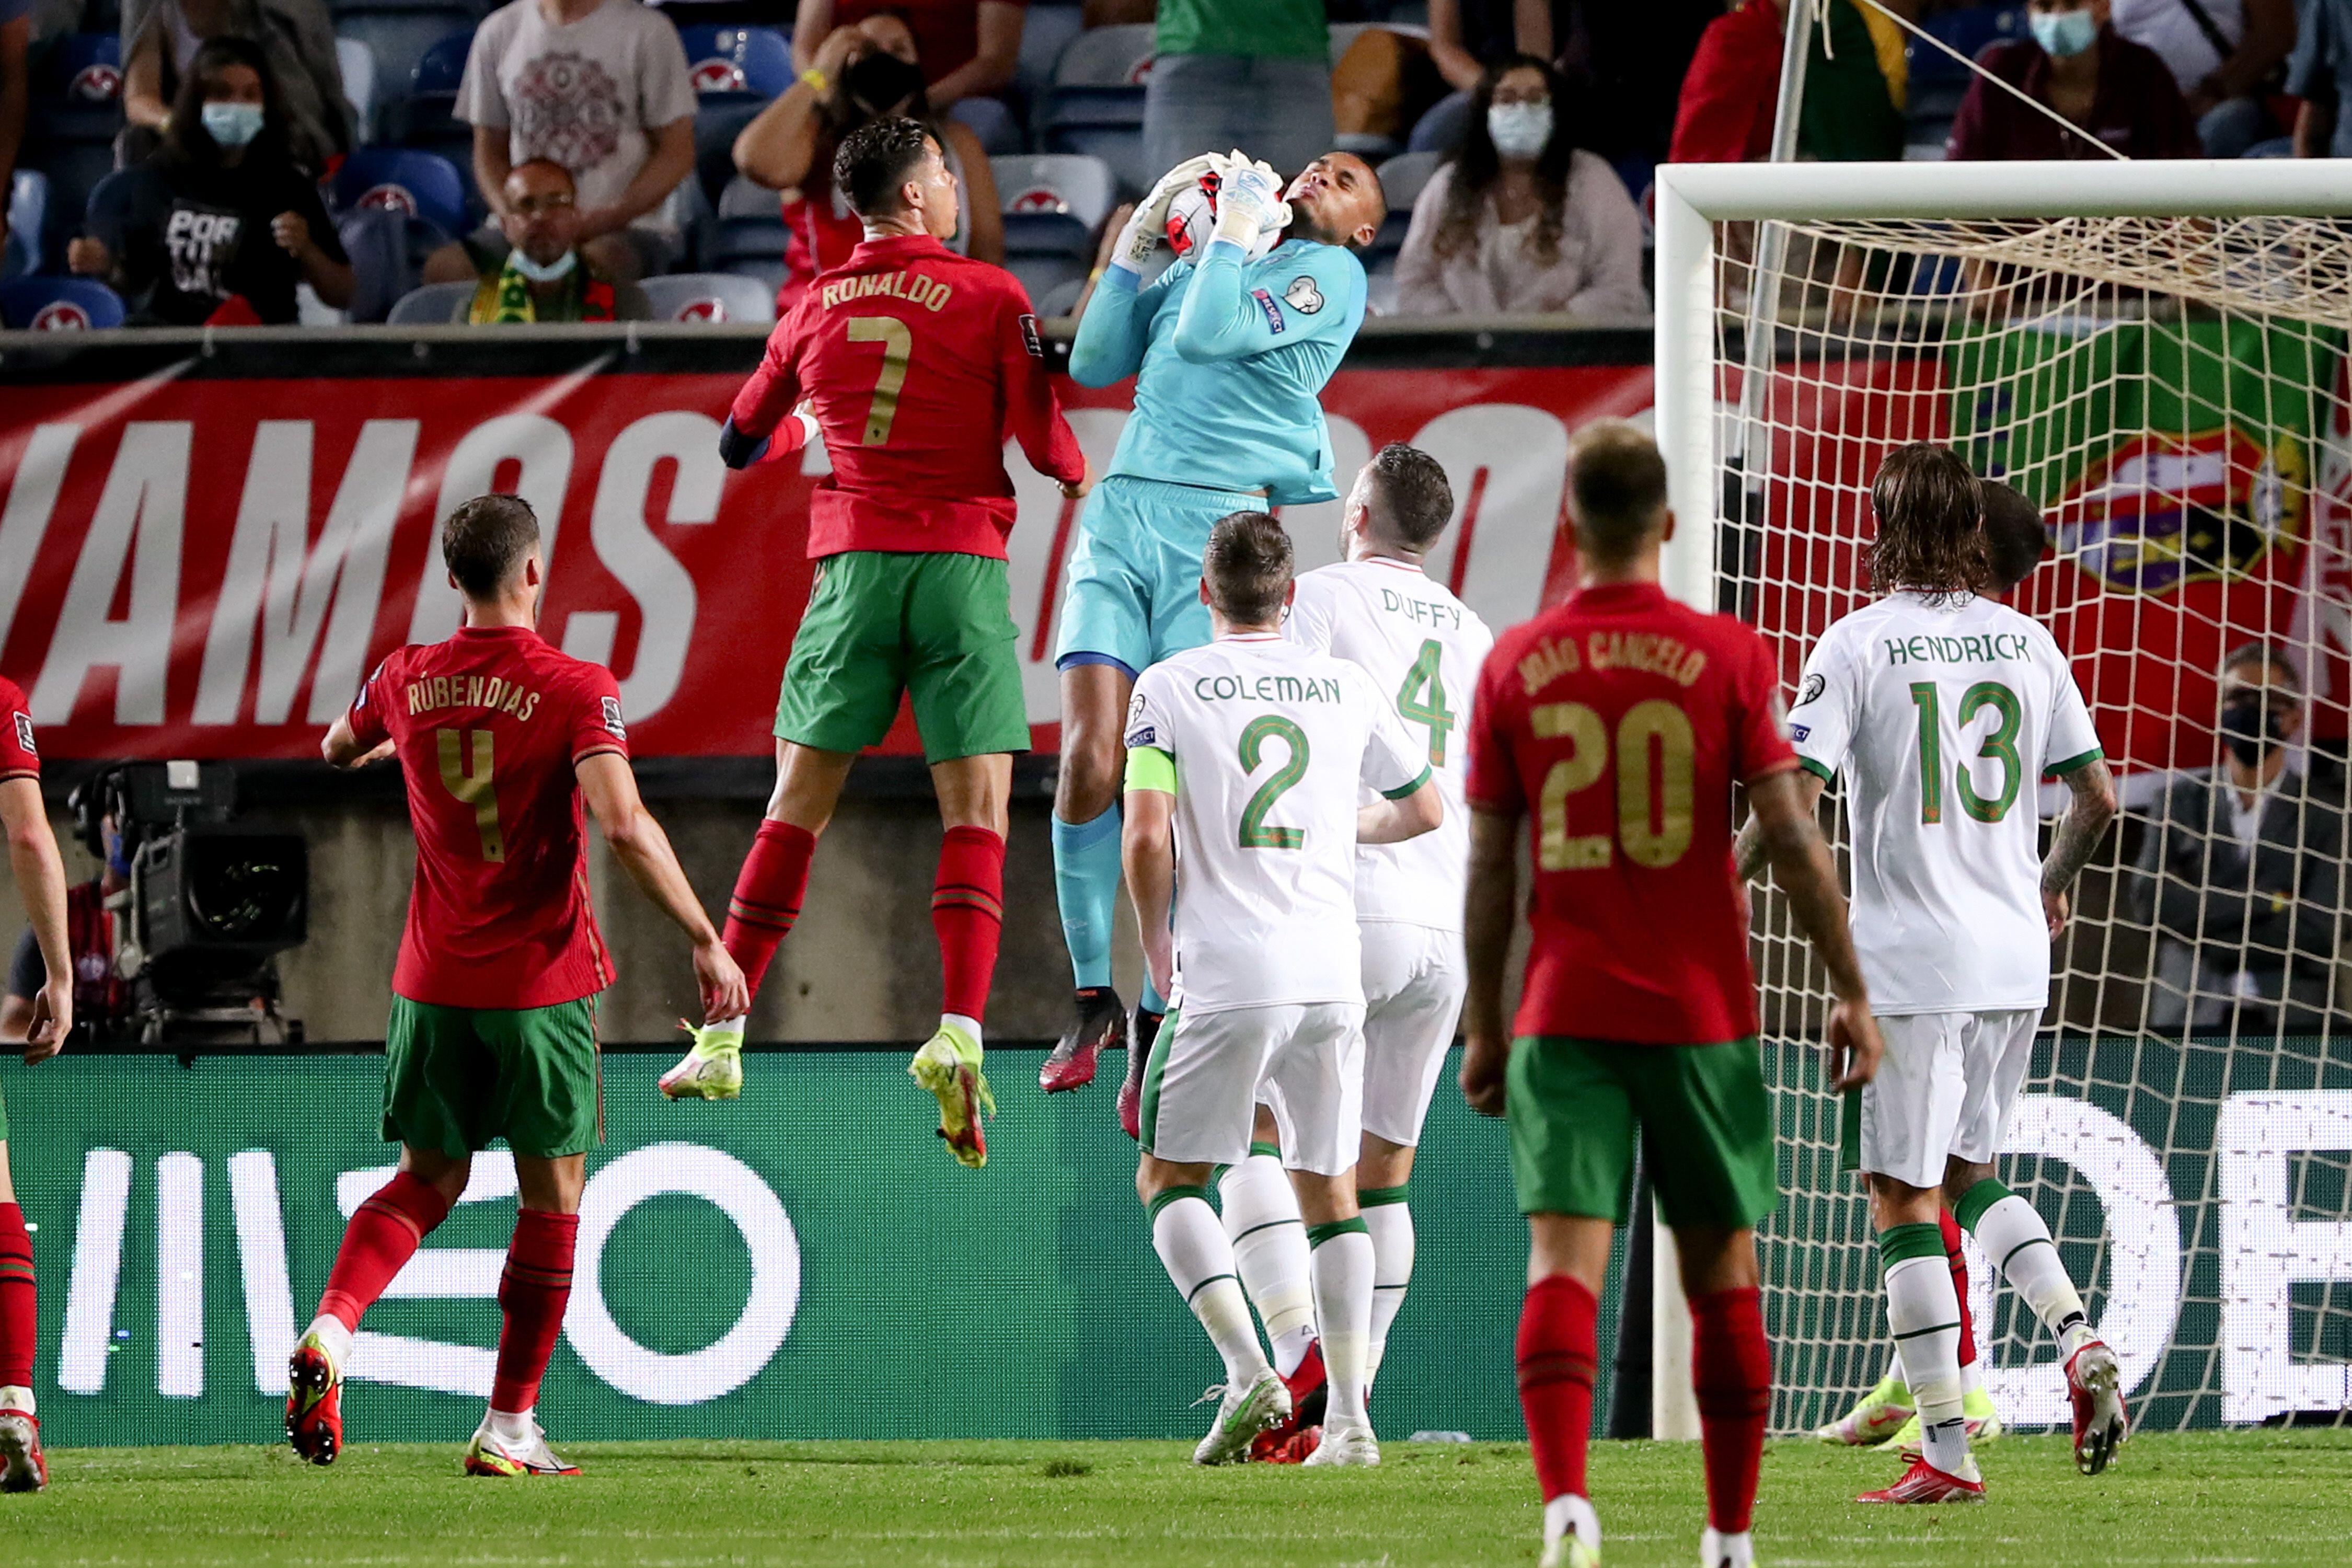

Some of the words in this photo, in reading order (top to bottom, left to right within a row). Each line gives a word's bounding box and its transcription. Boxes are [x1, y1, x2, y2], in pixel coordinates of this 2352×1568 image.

[822, 271, 952, 312] RONALDO
[847, 316, 912, 445] 7
[1381, 589, 1461, 630] DUFFY
[1588, 631, 1707, 688] CANCELO
[1885, 633, 2032, 665] HENDRICK
[1195, 676, 1341, 704] COLEMAN
[1397, 638, 1455, 768] 4
[1909, 681, 2022, 825] 13
[436, 728, 505, 863] 4
[1238, 714, 1310, 848] 2
[1530, 699, 1696, 872] 20
